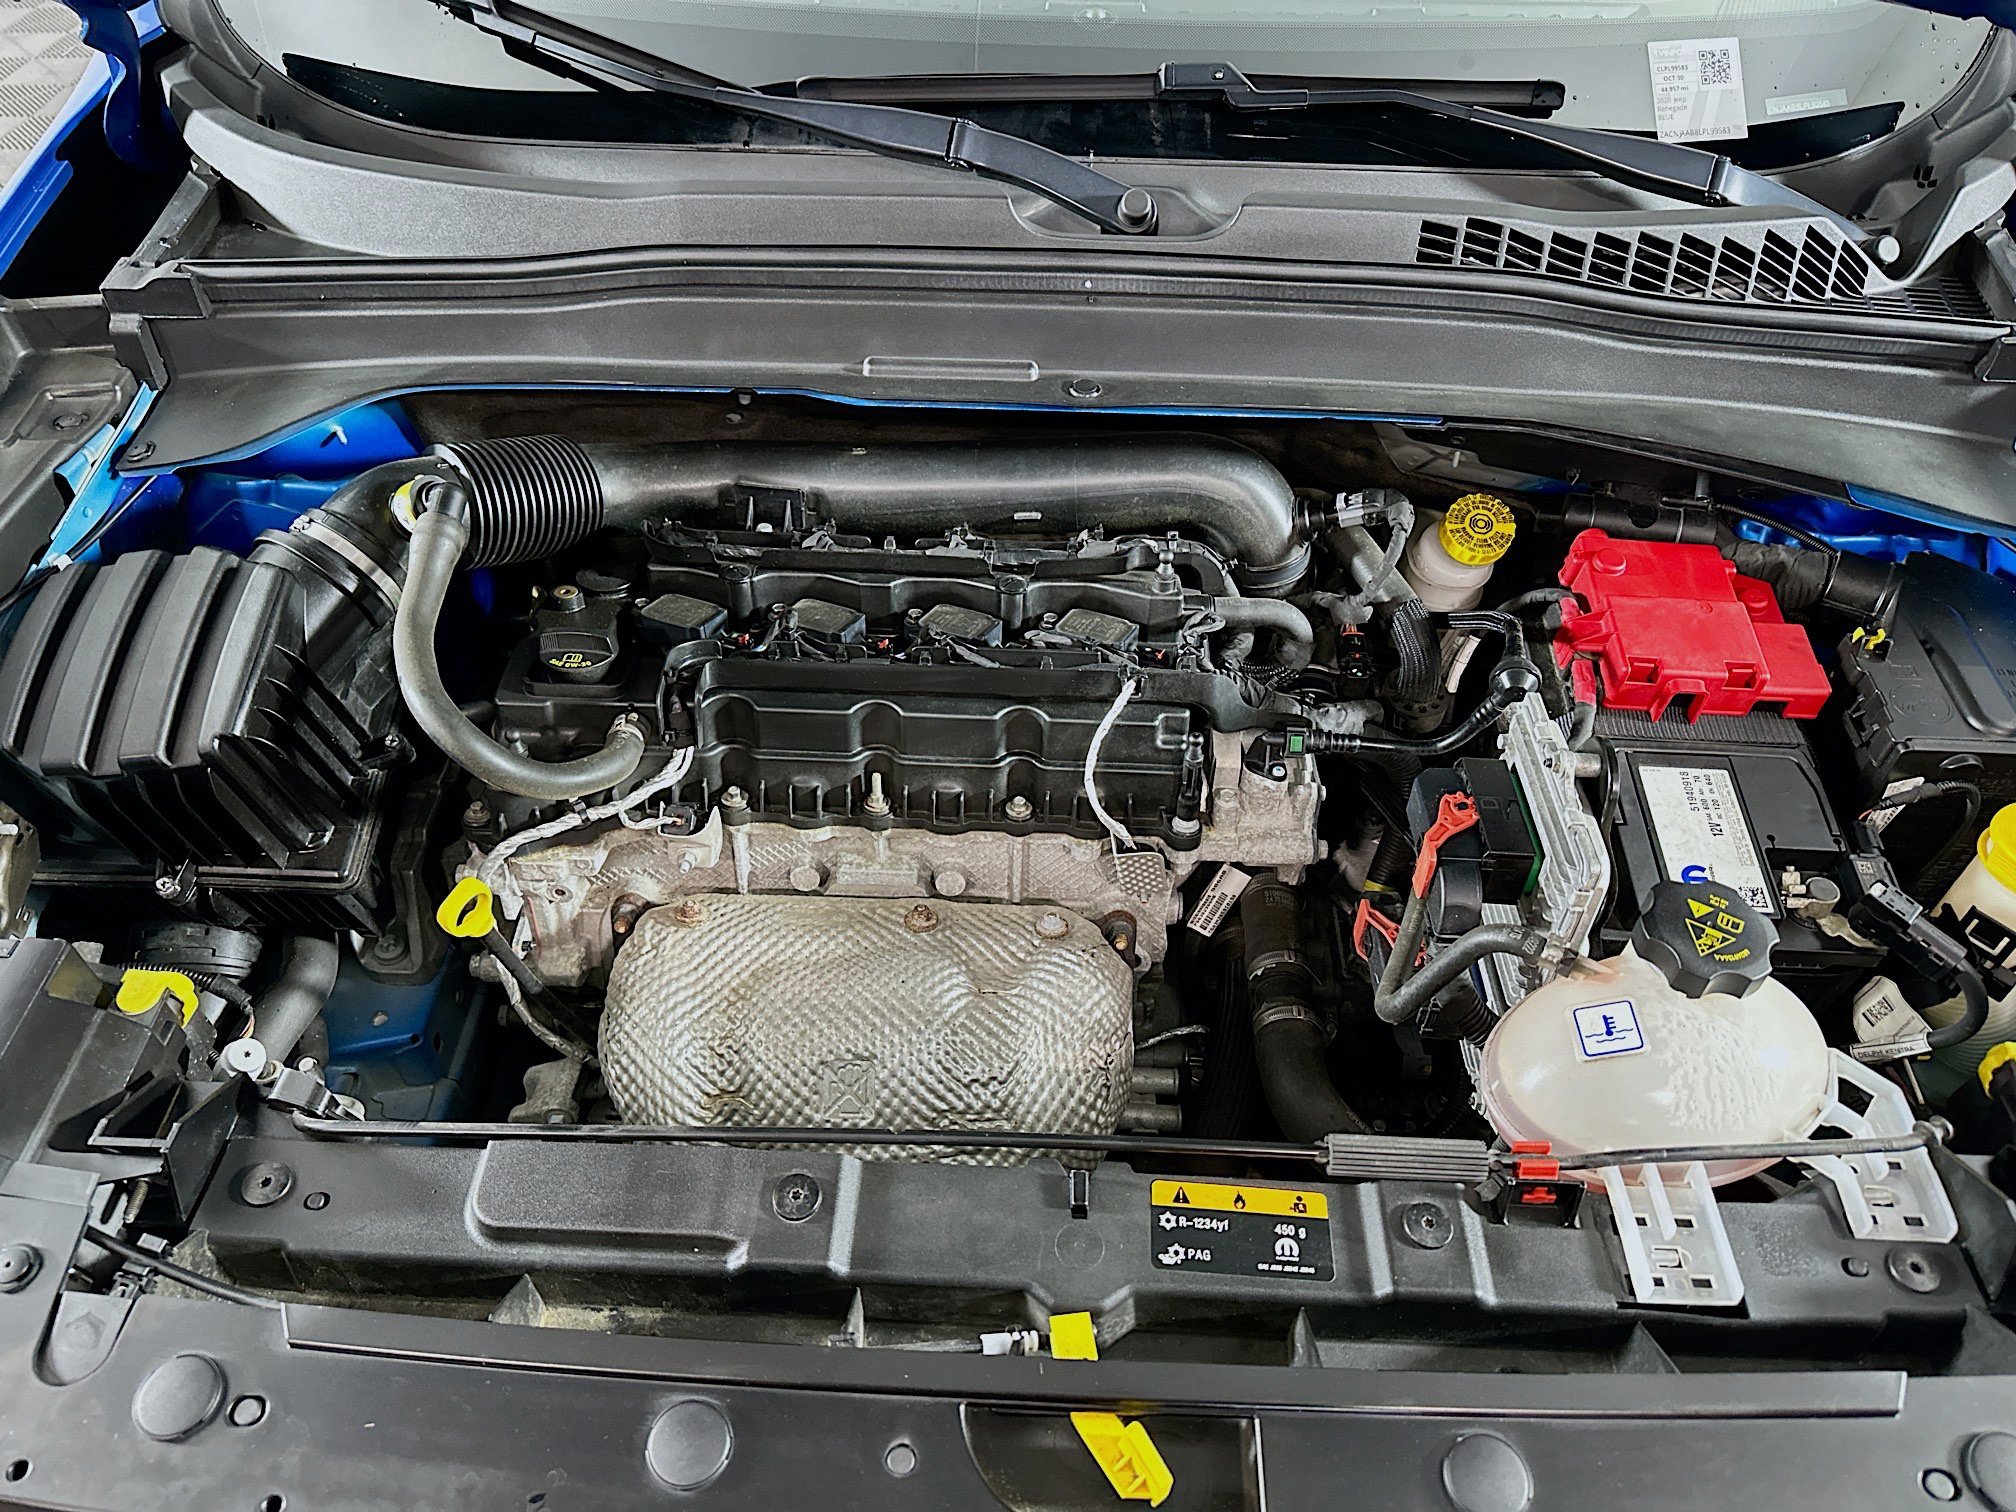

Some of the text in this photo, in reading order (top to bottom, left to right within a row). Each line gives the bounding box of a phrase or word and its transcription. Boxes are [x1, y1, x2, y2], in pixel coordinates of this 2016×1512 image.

[1656, 64, 1689, 72] CLPL99583
[1657, 105, 1688, 113] Renegade
[1693, 775, 1702, 783] 70
[1679, 771, 1700, 812] 51940918
[1711, 799, 1721, 810] 120
[1708, 822, 1724, 837] 12V
[1274, 1223, 1296, 1237] 450
[1298, 1227, 1307, 1240] g
[1187, 1248, 1212, 1261] PAG
